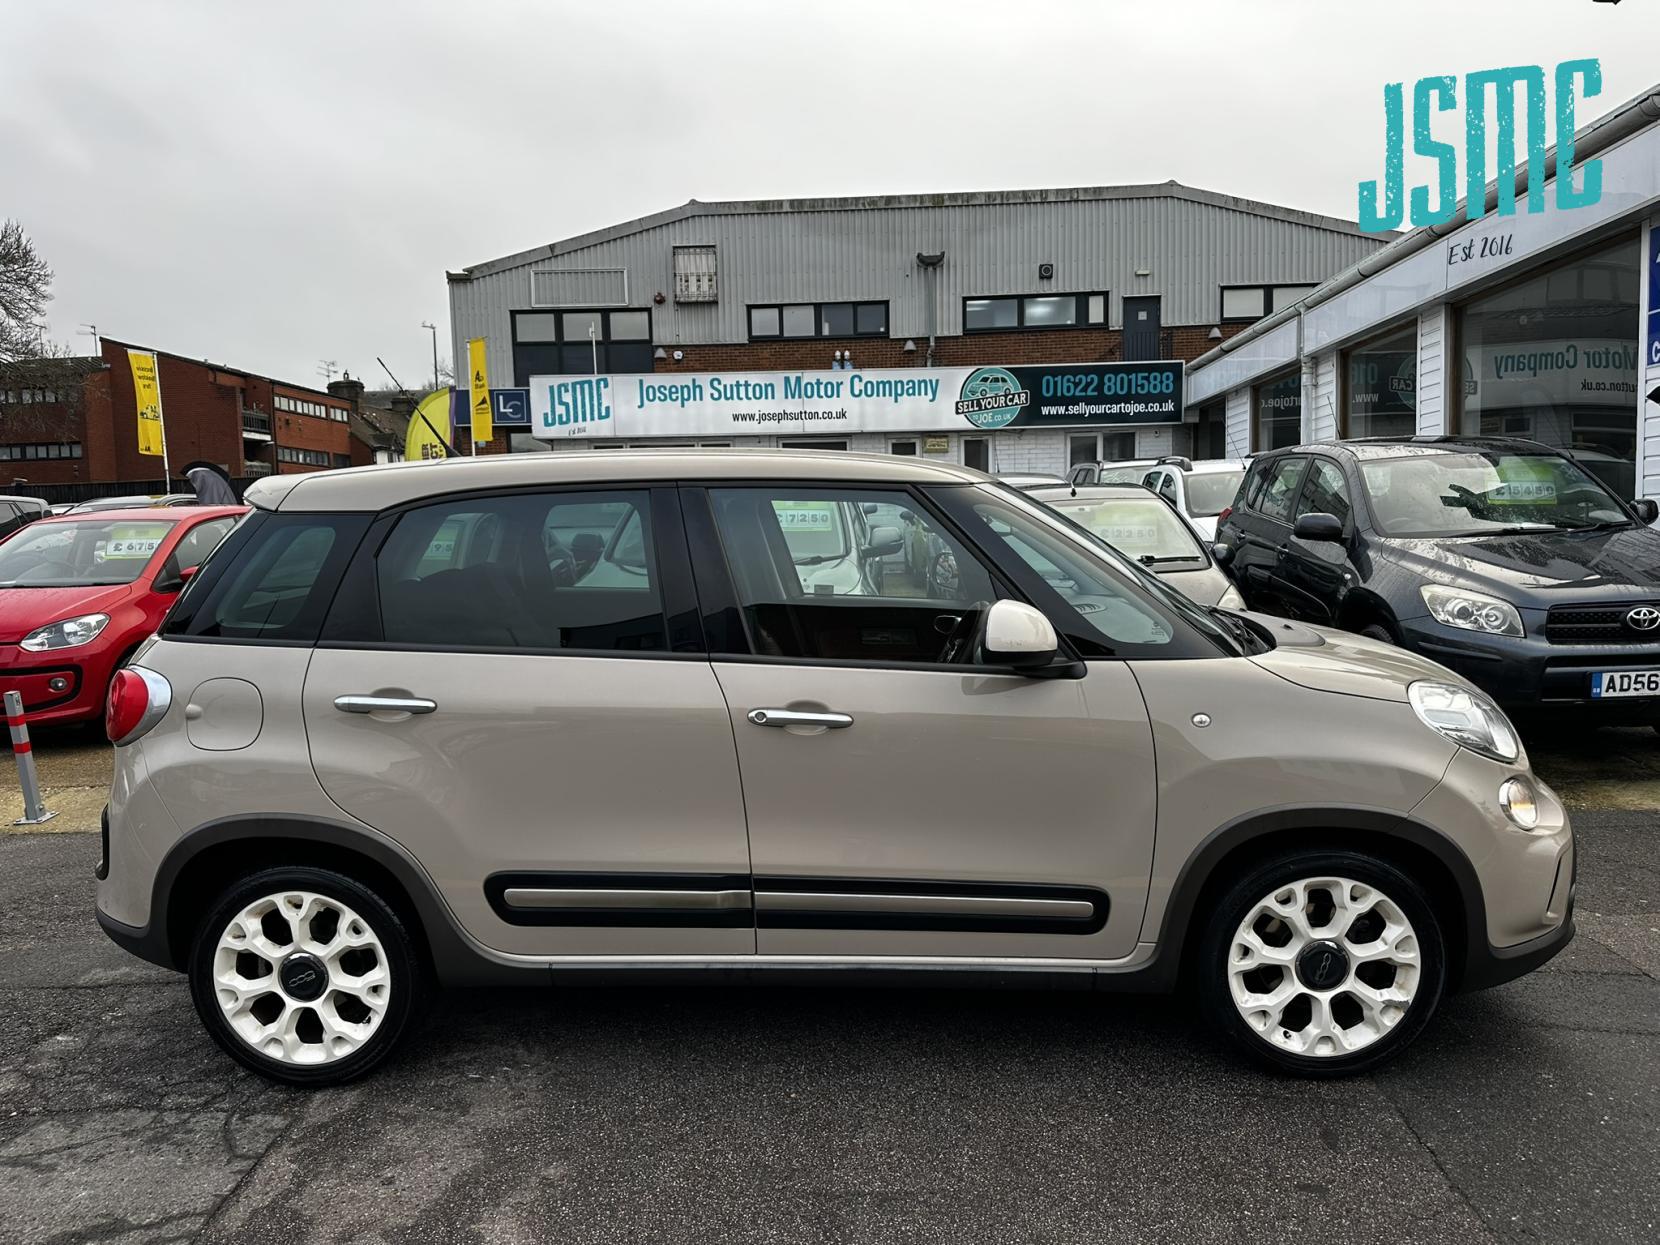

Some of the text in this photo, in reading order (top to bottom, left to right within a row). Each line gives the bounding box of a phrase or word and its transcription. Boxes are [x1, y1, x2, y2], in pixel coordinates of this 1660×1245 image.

[638, 374, 939, 408] Joseph Sutton Motor Company
[1042, 372, 1174, 397] 01622 801588
[543, 377, 610, 427] JSMC
[957, 393, 1026, 413] SELL YOUR CAR
[1041, 400, 1174, 417] www.sellyourcartojoe.co.uk
[732, 408, 847, 424] www.josephsutton.co.uk
